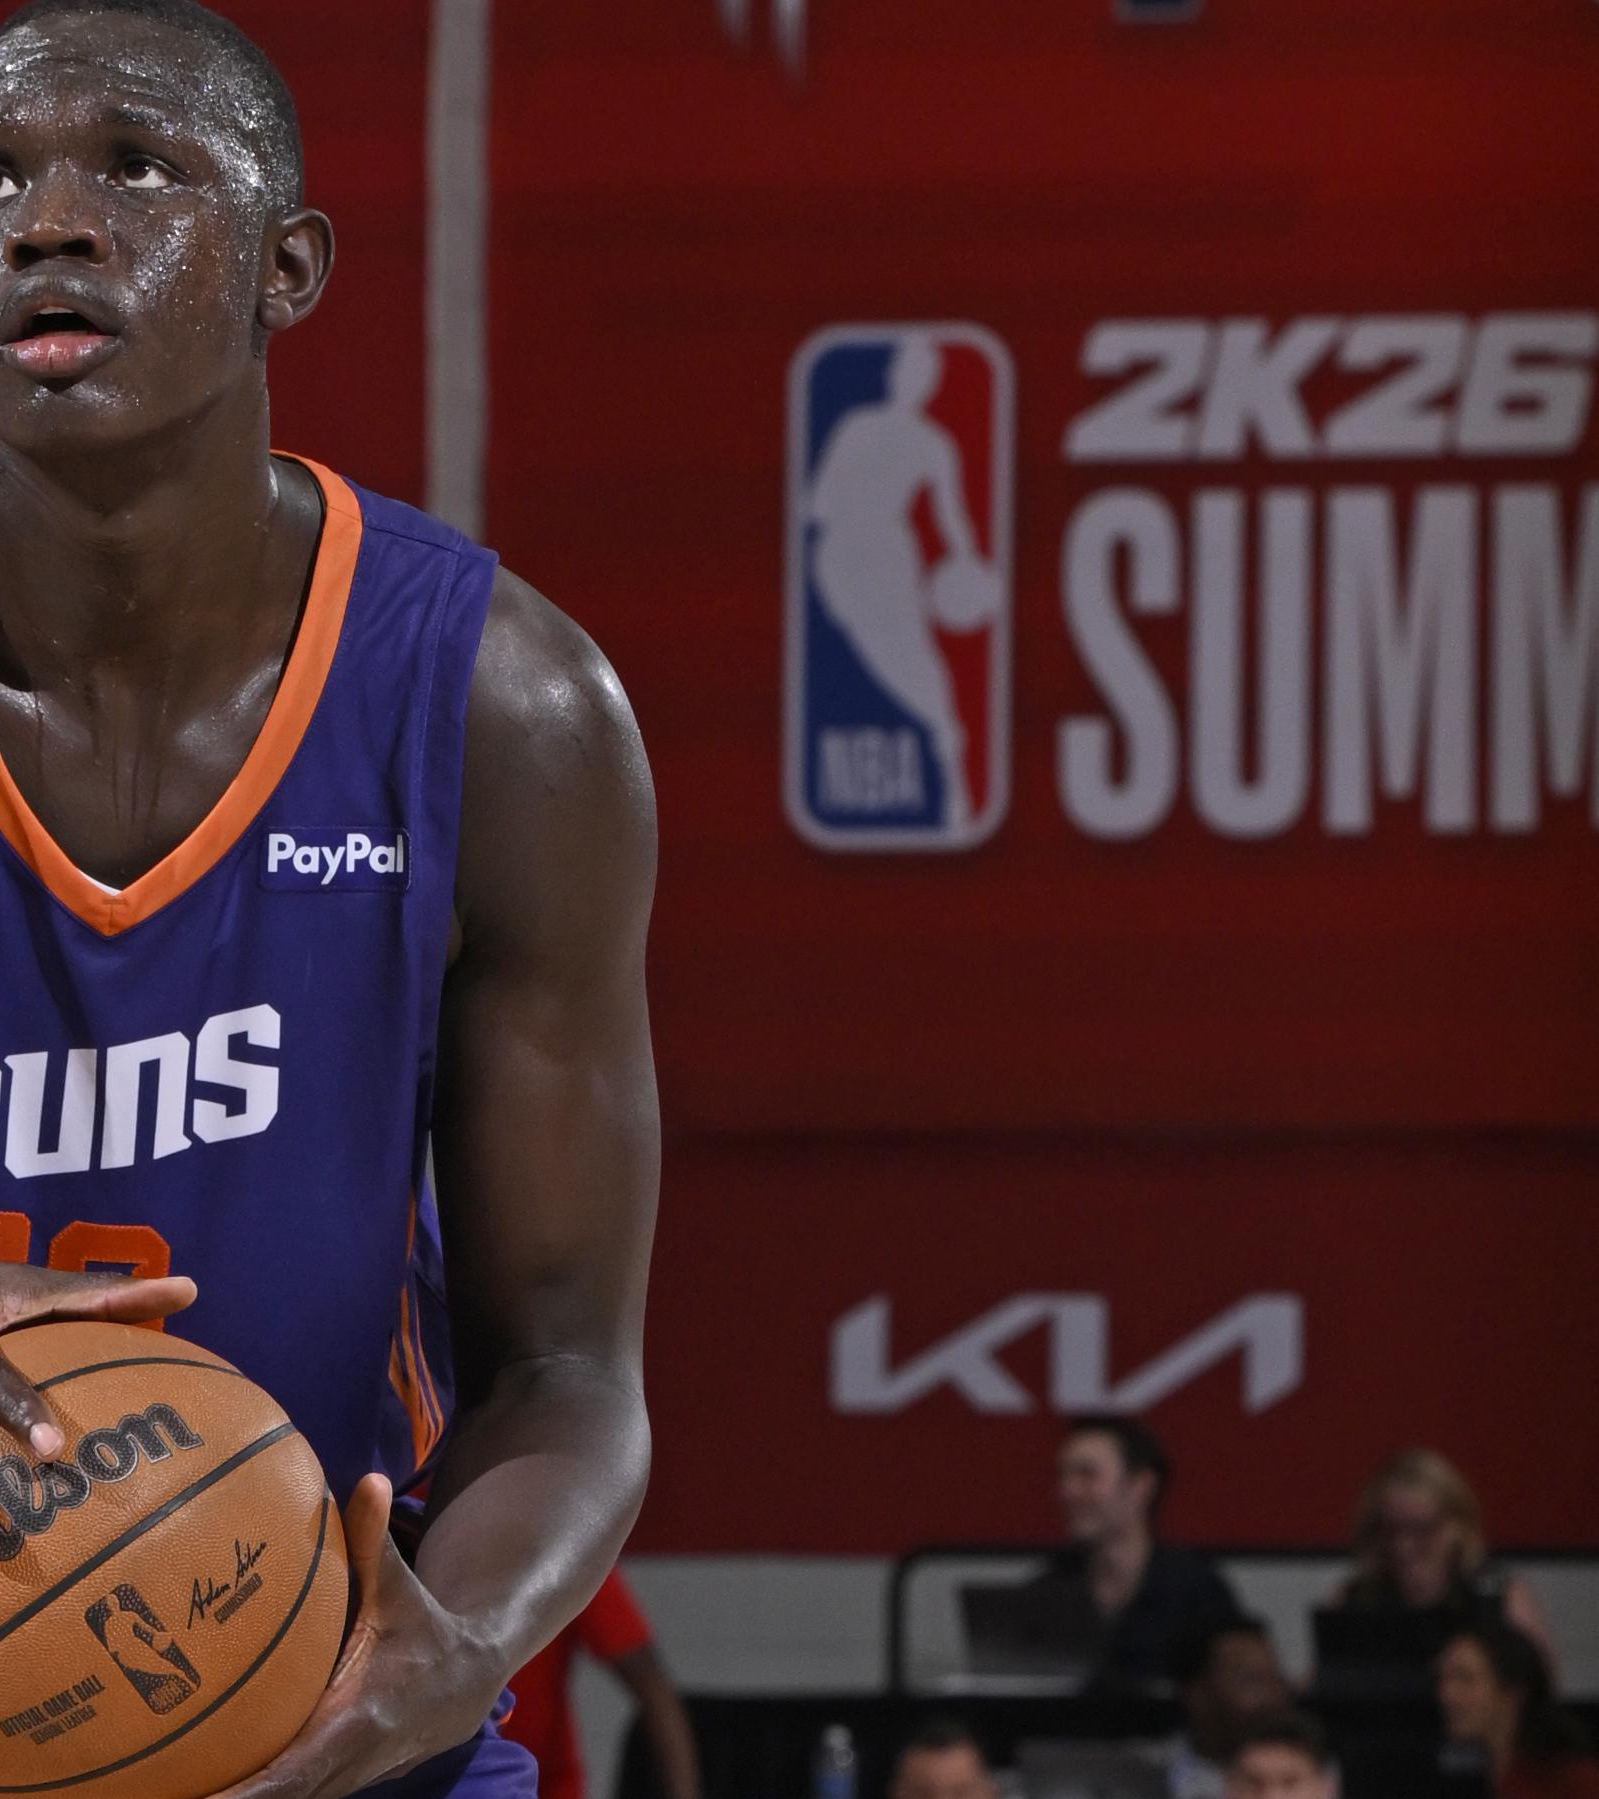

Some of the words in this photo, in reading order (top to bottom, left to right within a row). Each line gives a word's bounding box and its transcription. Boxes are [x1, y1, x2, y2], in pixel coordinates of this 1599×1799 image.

[1064, 312, 1598, 462] 2K26
[1057, 484, 1599, 840] SUMM
[818, 724, 926, 810] NBA
[267, 832, 404, 886] PayPal
[832, 1291, 1305, 1415] KIA
[42, 1689, 80, 1719] GAME
[70, 1674, 106, 1703] BALL
